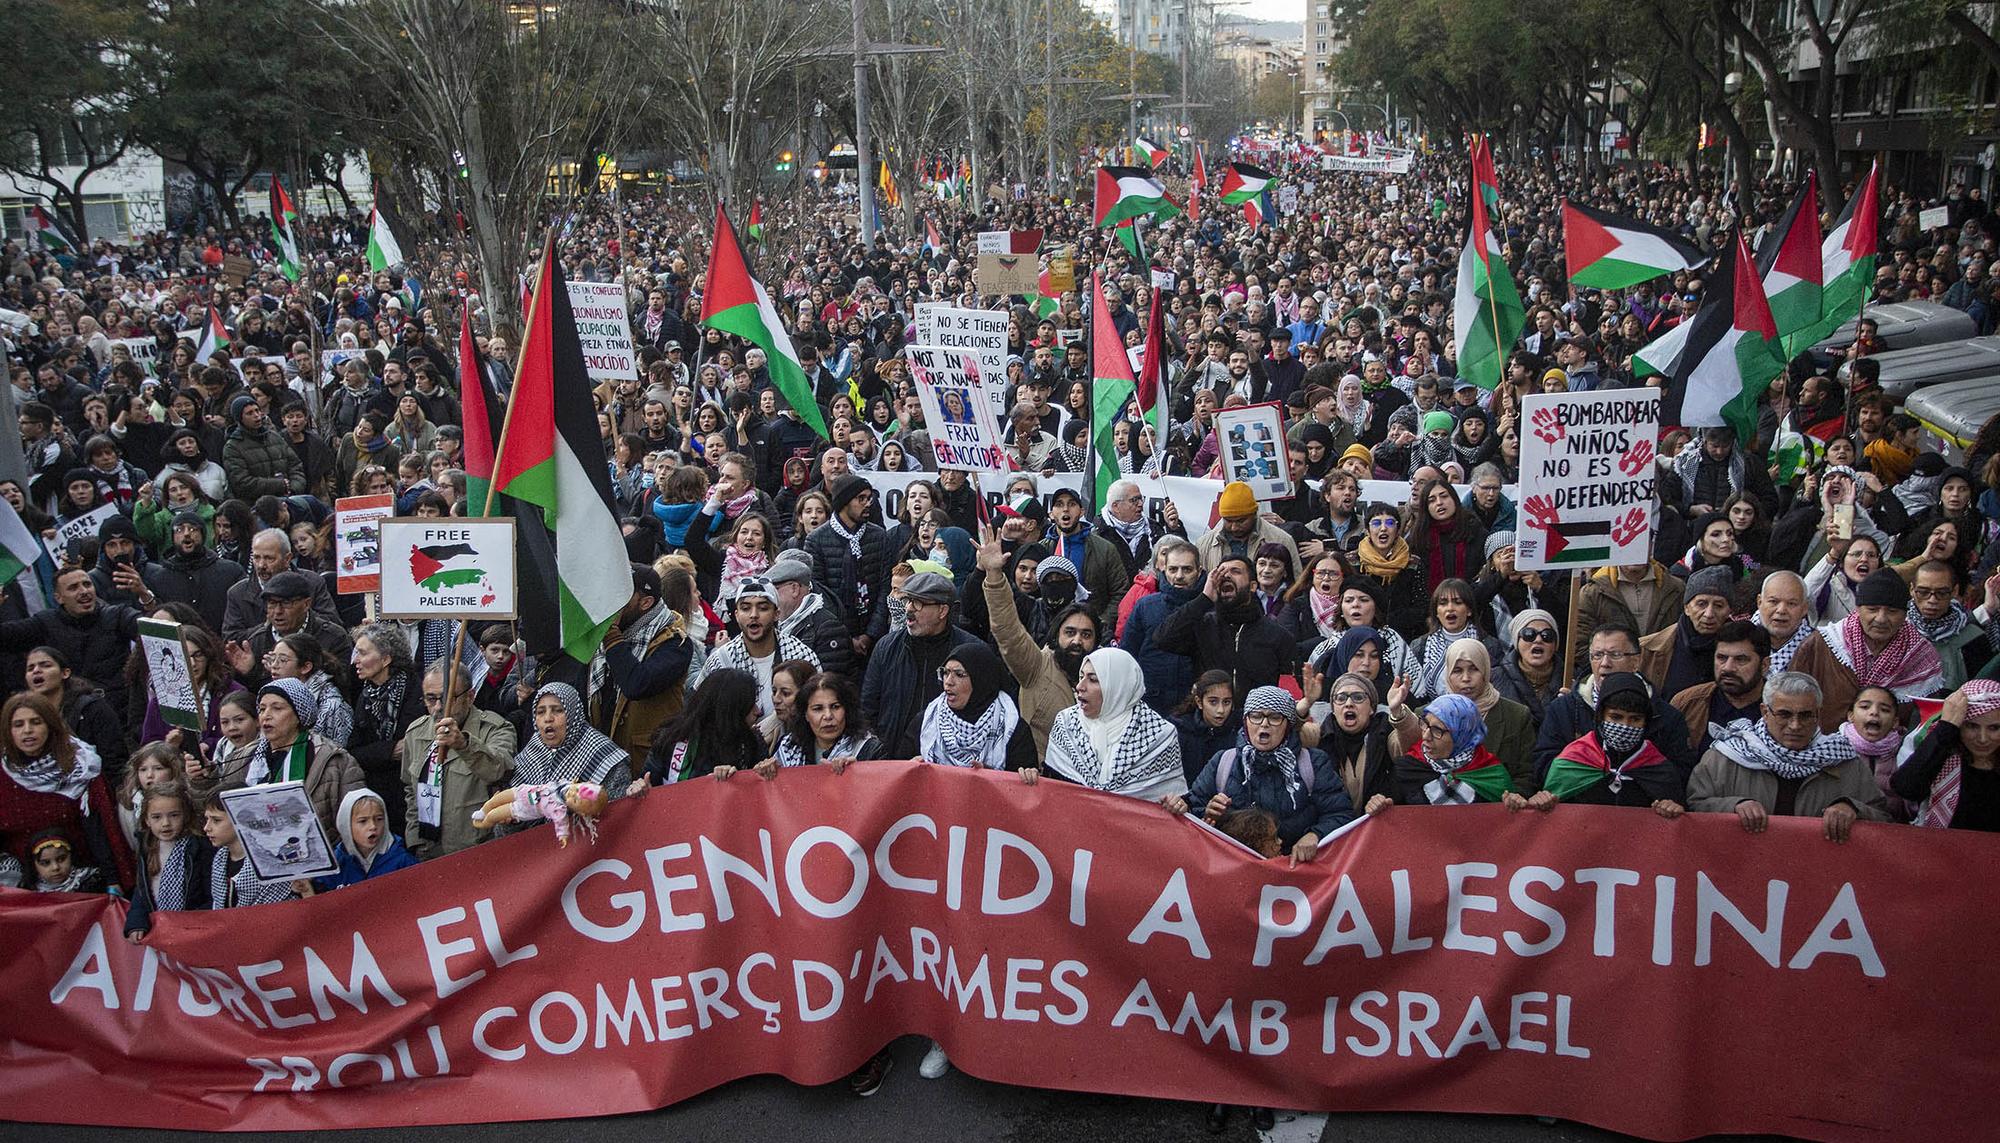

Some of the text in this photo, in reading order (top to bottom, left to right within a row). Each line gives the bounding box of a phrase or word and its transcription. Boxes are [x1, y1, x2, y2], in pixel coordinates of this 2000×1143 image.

[572, 285, 580, 294] ES
[592, 286, 622, 296] CONFLICTO
[572, 306, 623, 320] OLONIALISMO
[937, 316, 951, 328] NO
[957, 317, 969, 329] SE
[585, 354, 630, 370] ENOCIDIO
[912, 350, 962, 369] NOT IN
[926, 372, 982, 388] OUR NAME
[1557, 399, 1660, 426] BOMBARDEAR
[946, 425, 979, 441] FRAU
[1567, 429, 1630, 454] NIÑOS
[936, 444, 1001, 469] GENOCIDE
[1543, 457, 1611, 478] NO ES
[1555, 478, 1655, 510] DEFENDERSE
[425, 530, 471, 541] FREE
[420, 596, 477, 606] PALESTINE
[417, 898, 538, 998] EL
[562, 814, 1094, 943] GENOCIDI
[1128, 868, 1212, 960] A
[1252, 862, 1886, 978] PALESTINA
[473, 952, 782, 1062] COMERÇ
[1110, 978, 1290, 1057] AMB
[1322, 990, 1591, 1059] ISRAEL
